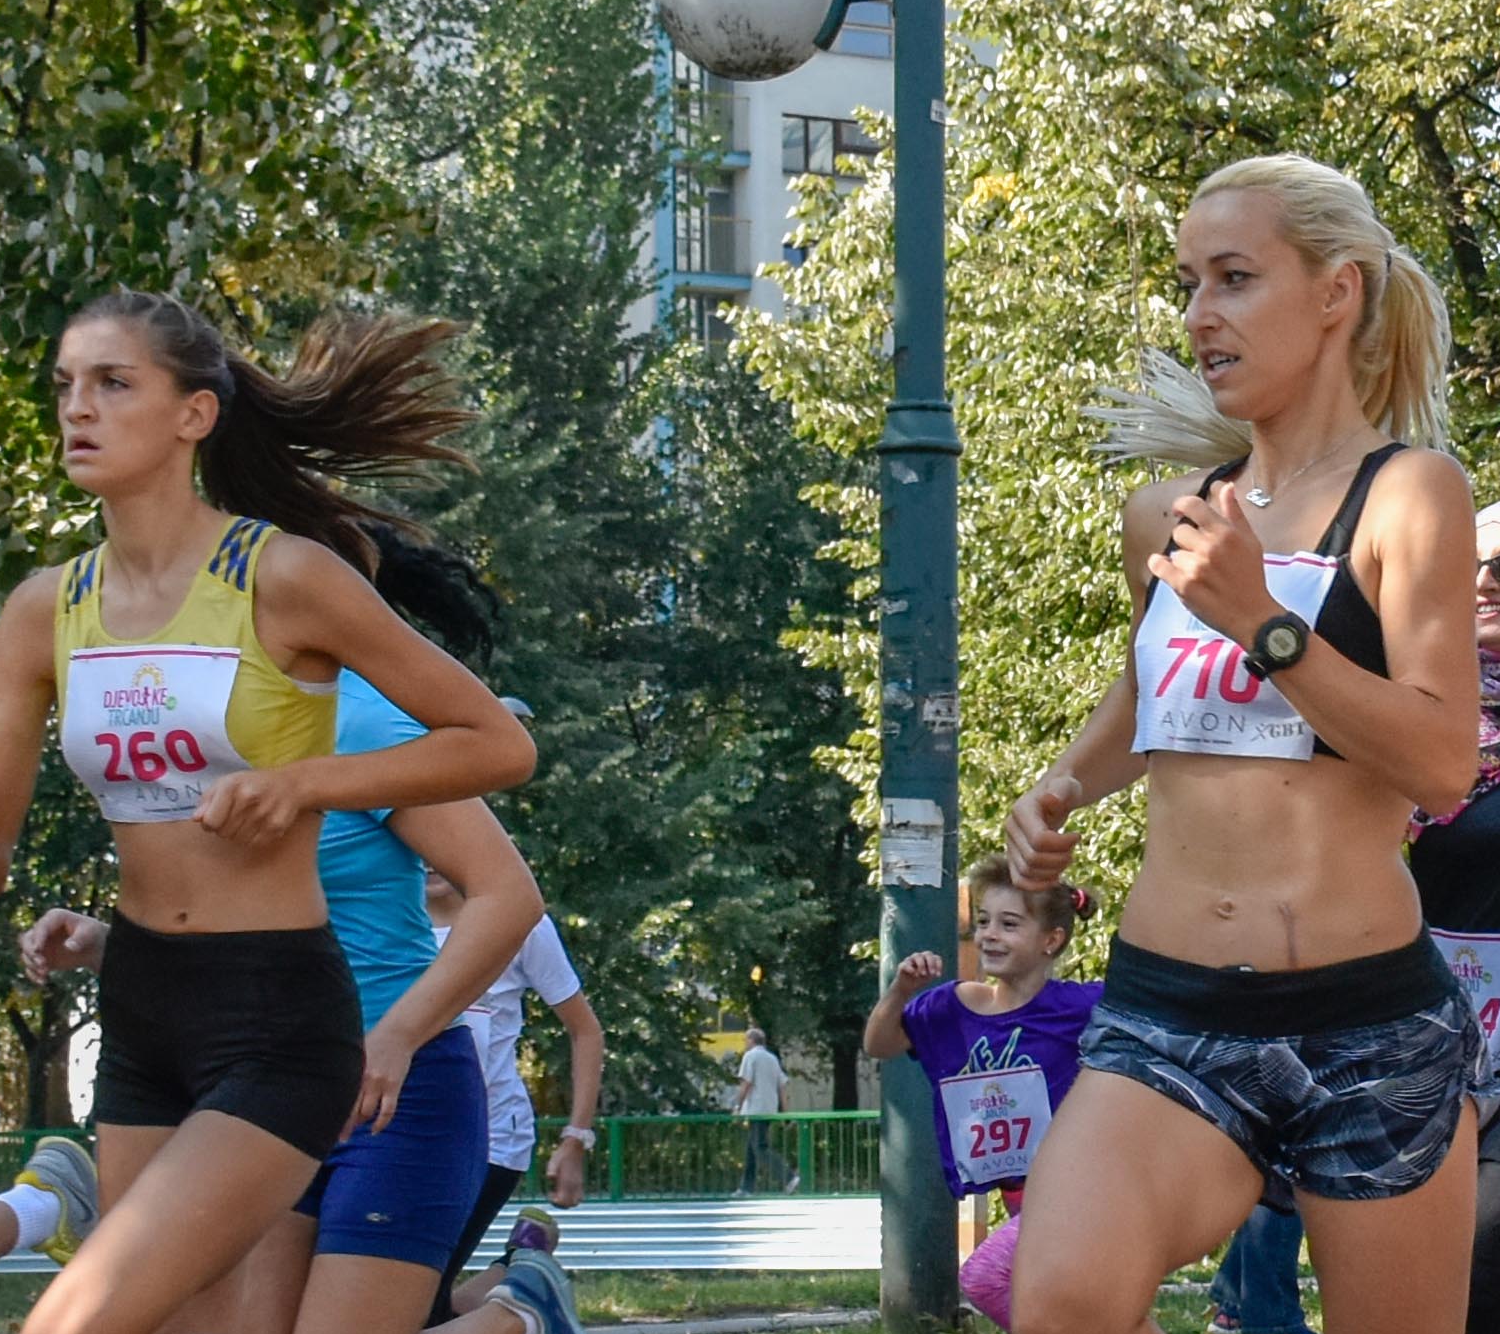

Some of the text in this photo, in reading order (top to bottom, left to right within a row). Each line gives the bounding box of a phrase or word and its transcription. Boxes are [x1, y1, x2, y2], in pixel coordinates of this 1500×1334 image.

[1155, 637, 1261, 704] 710
[1160, 710, 1246, 733] AVON
[95, 729, 208, 782] 260
[136, 782, 202, 803] AVON
[970, 1117, 1032, 1159] 297
[982, 1155, 1029, 1172] AVON
